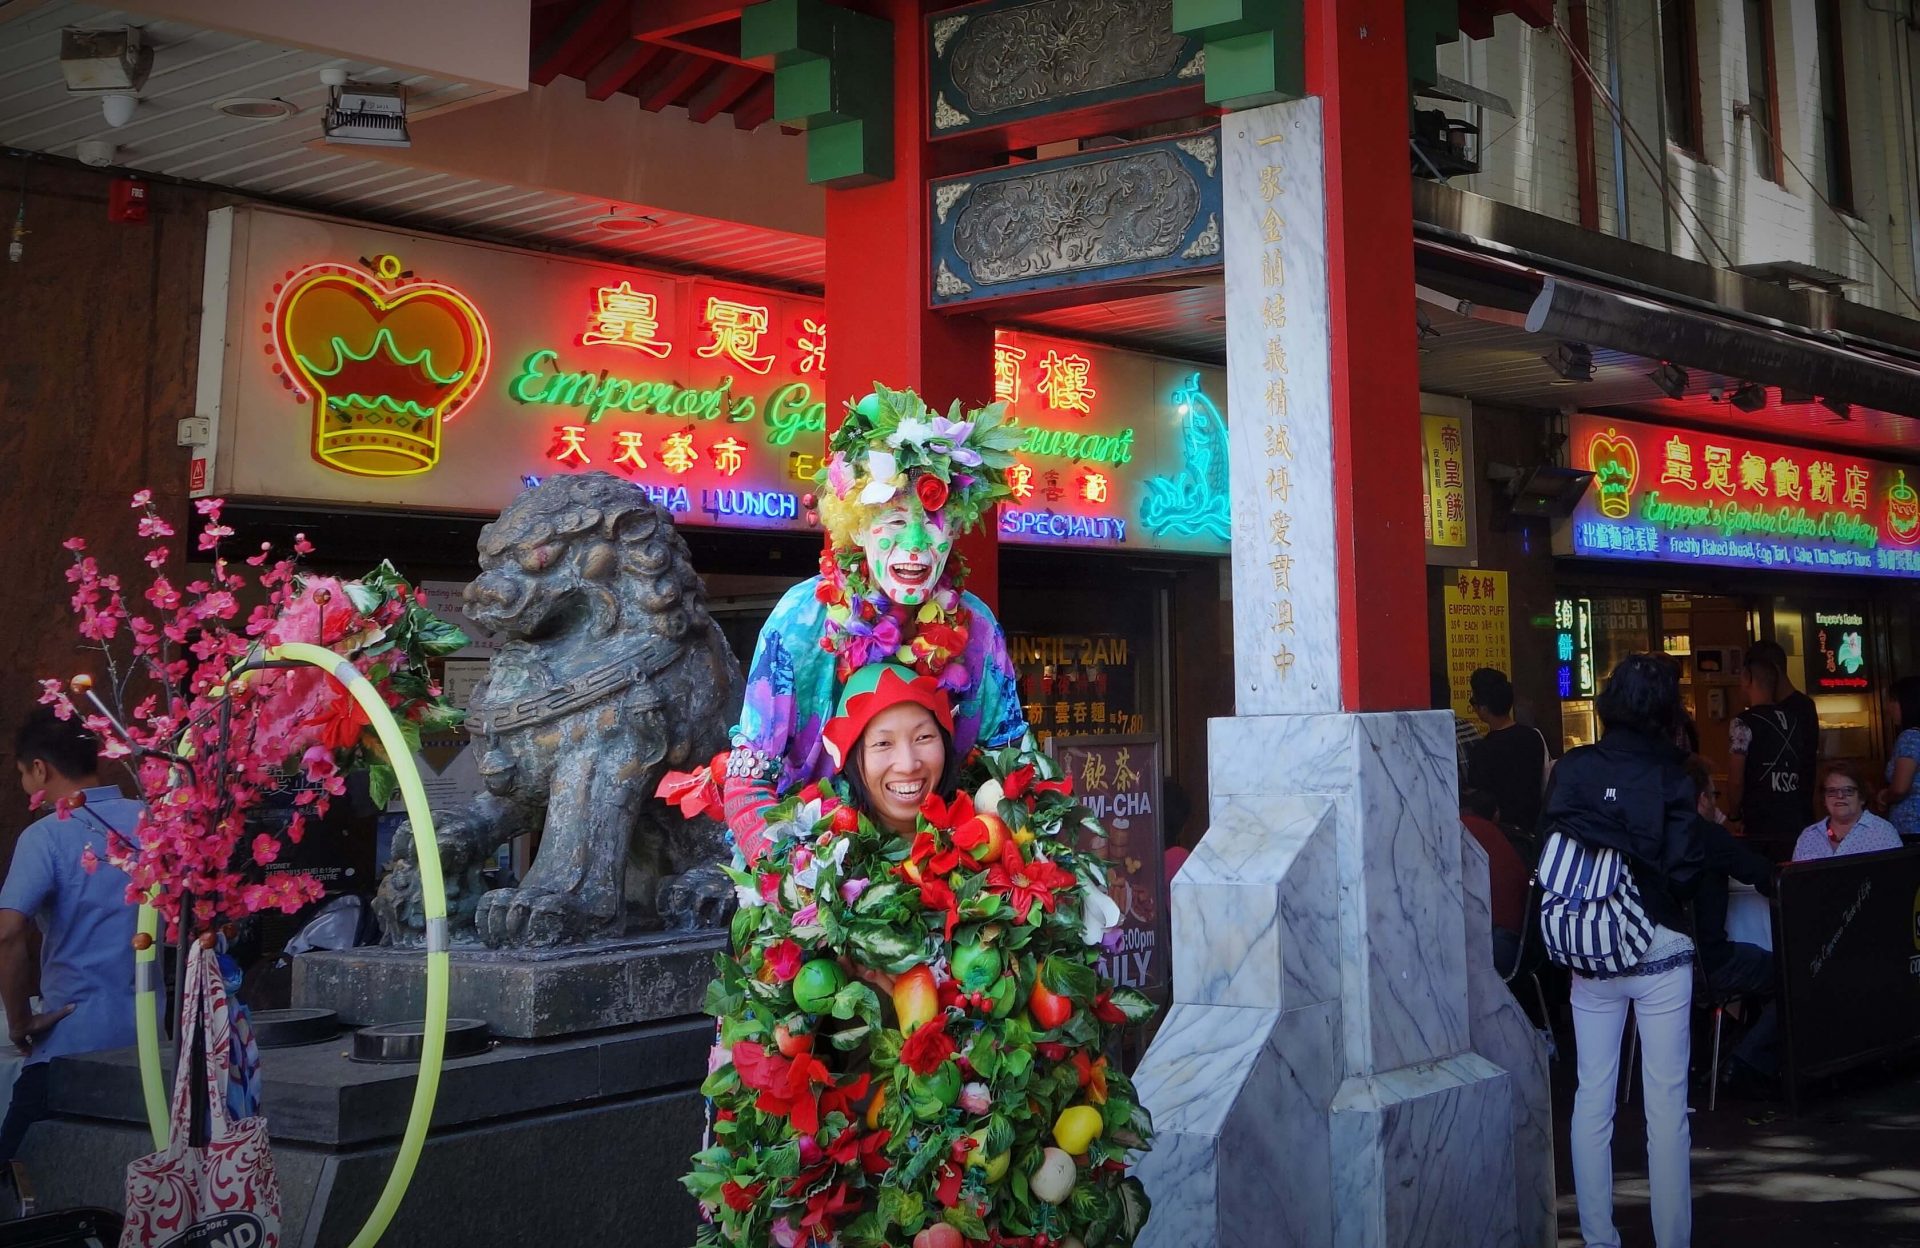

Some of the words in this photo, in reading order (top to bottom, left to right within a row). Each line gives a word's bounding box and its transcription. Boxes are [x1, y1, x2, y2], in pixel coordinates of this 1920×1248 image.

[509, 350, 756, 423] Emperor's
[716, 488, 799, 518] LUNCH
[1003, 511, 1126, 540] SPECIALTY
[1647, 491, 1721, 529] Emperor's
[1724, 501, 1776, 536] Garden
[1778, 506, 1816, 535] Cakes
[1832, 511, 1878, 549] Bakery
[1669, 536, 1700, 557] Freshly
[1701, 538, 1728, 556] Baked
[1449, 603, 1486, 616] EMPEROR'S
[1489, 605, 1505, 616] PUFF
[1464, 621, 1479, 631] EACH
[1464, 633, 1475, 644] FOR
[1080, 638, 1128, 665] 2AM
[1465, 647, 1474, 657] FOR
[1081, 747, 1138, 792] 飲茶
